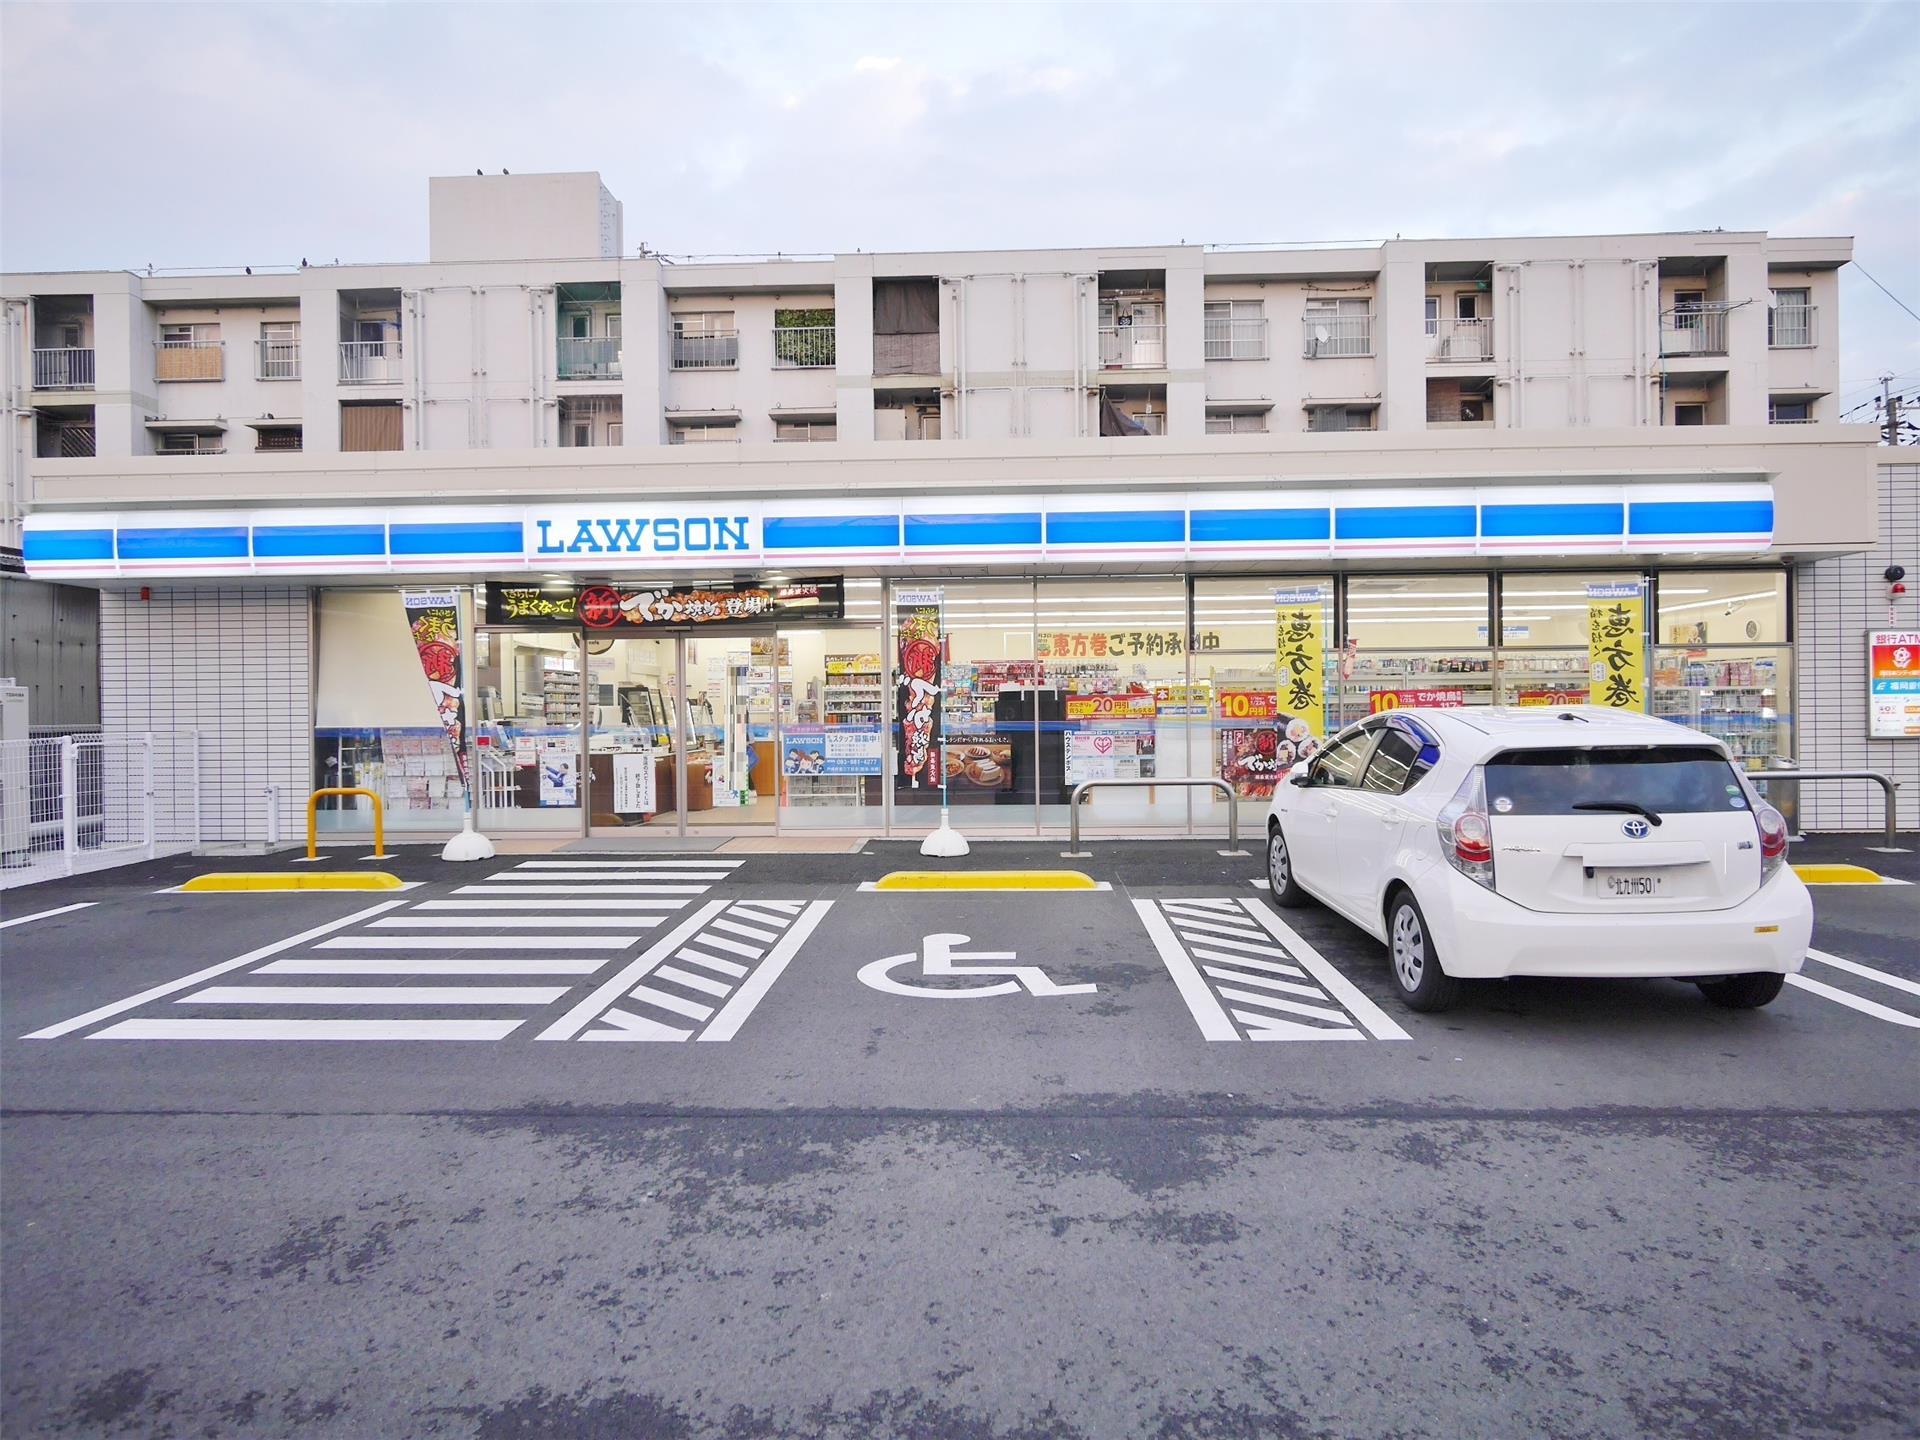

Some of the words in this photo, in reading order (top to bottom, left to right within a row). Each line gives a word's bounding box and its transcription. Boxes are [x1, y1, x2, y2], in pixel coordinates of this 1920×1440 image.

[537, 517, 749, 553] LAWSON
[505, 597, 577, 618] うまくなって!
[585, 591, 614, 621] 新
[725, 596, 774, 614] 登場!!
[1052, 632, 1220, 657] 恵方巻ご予約承中
[1889, 682, 1920, 691] 福岡銀
[1092, 698, 1113, 713] 20
[1222, 695, 1249, 716] 10
[1249, 707, 1267, 715] 円引
